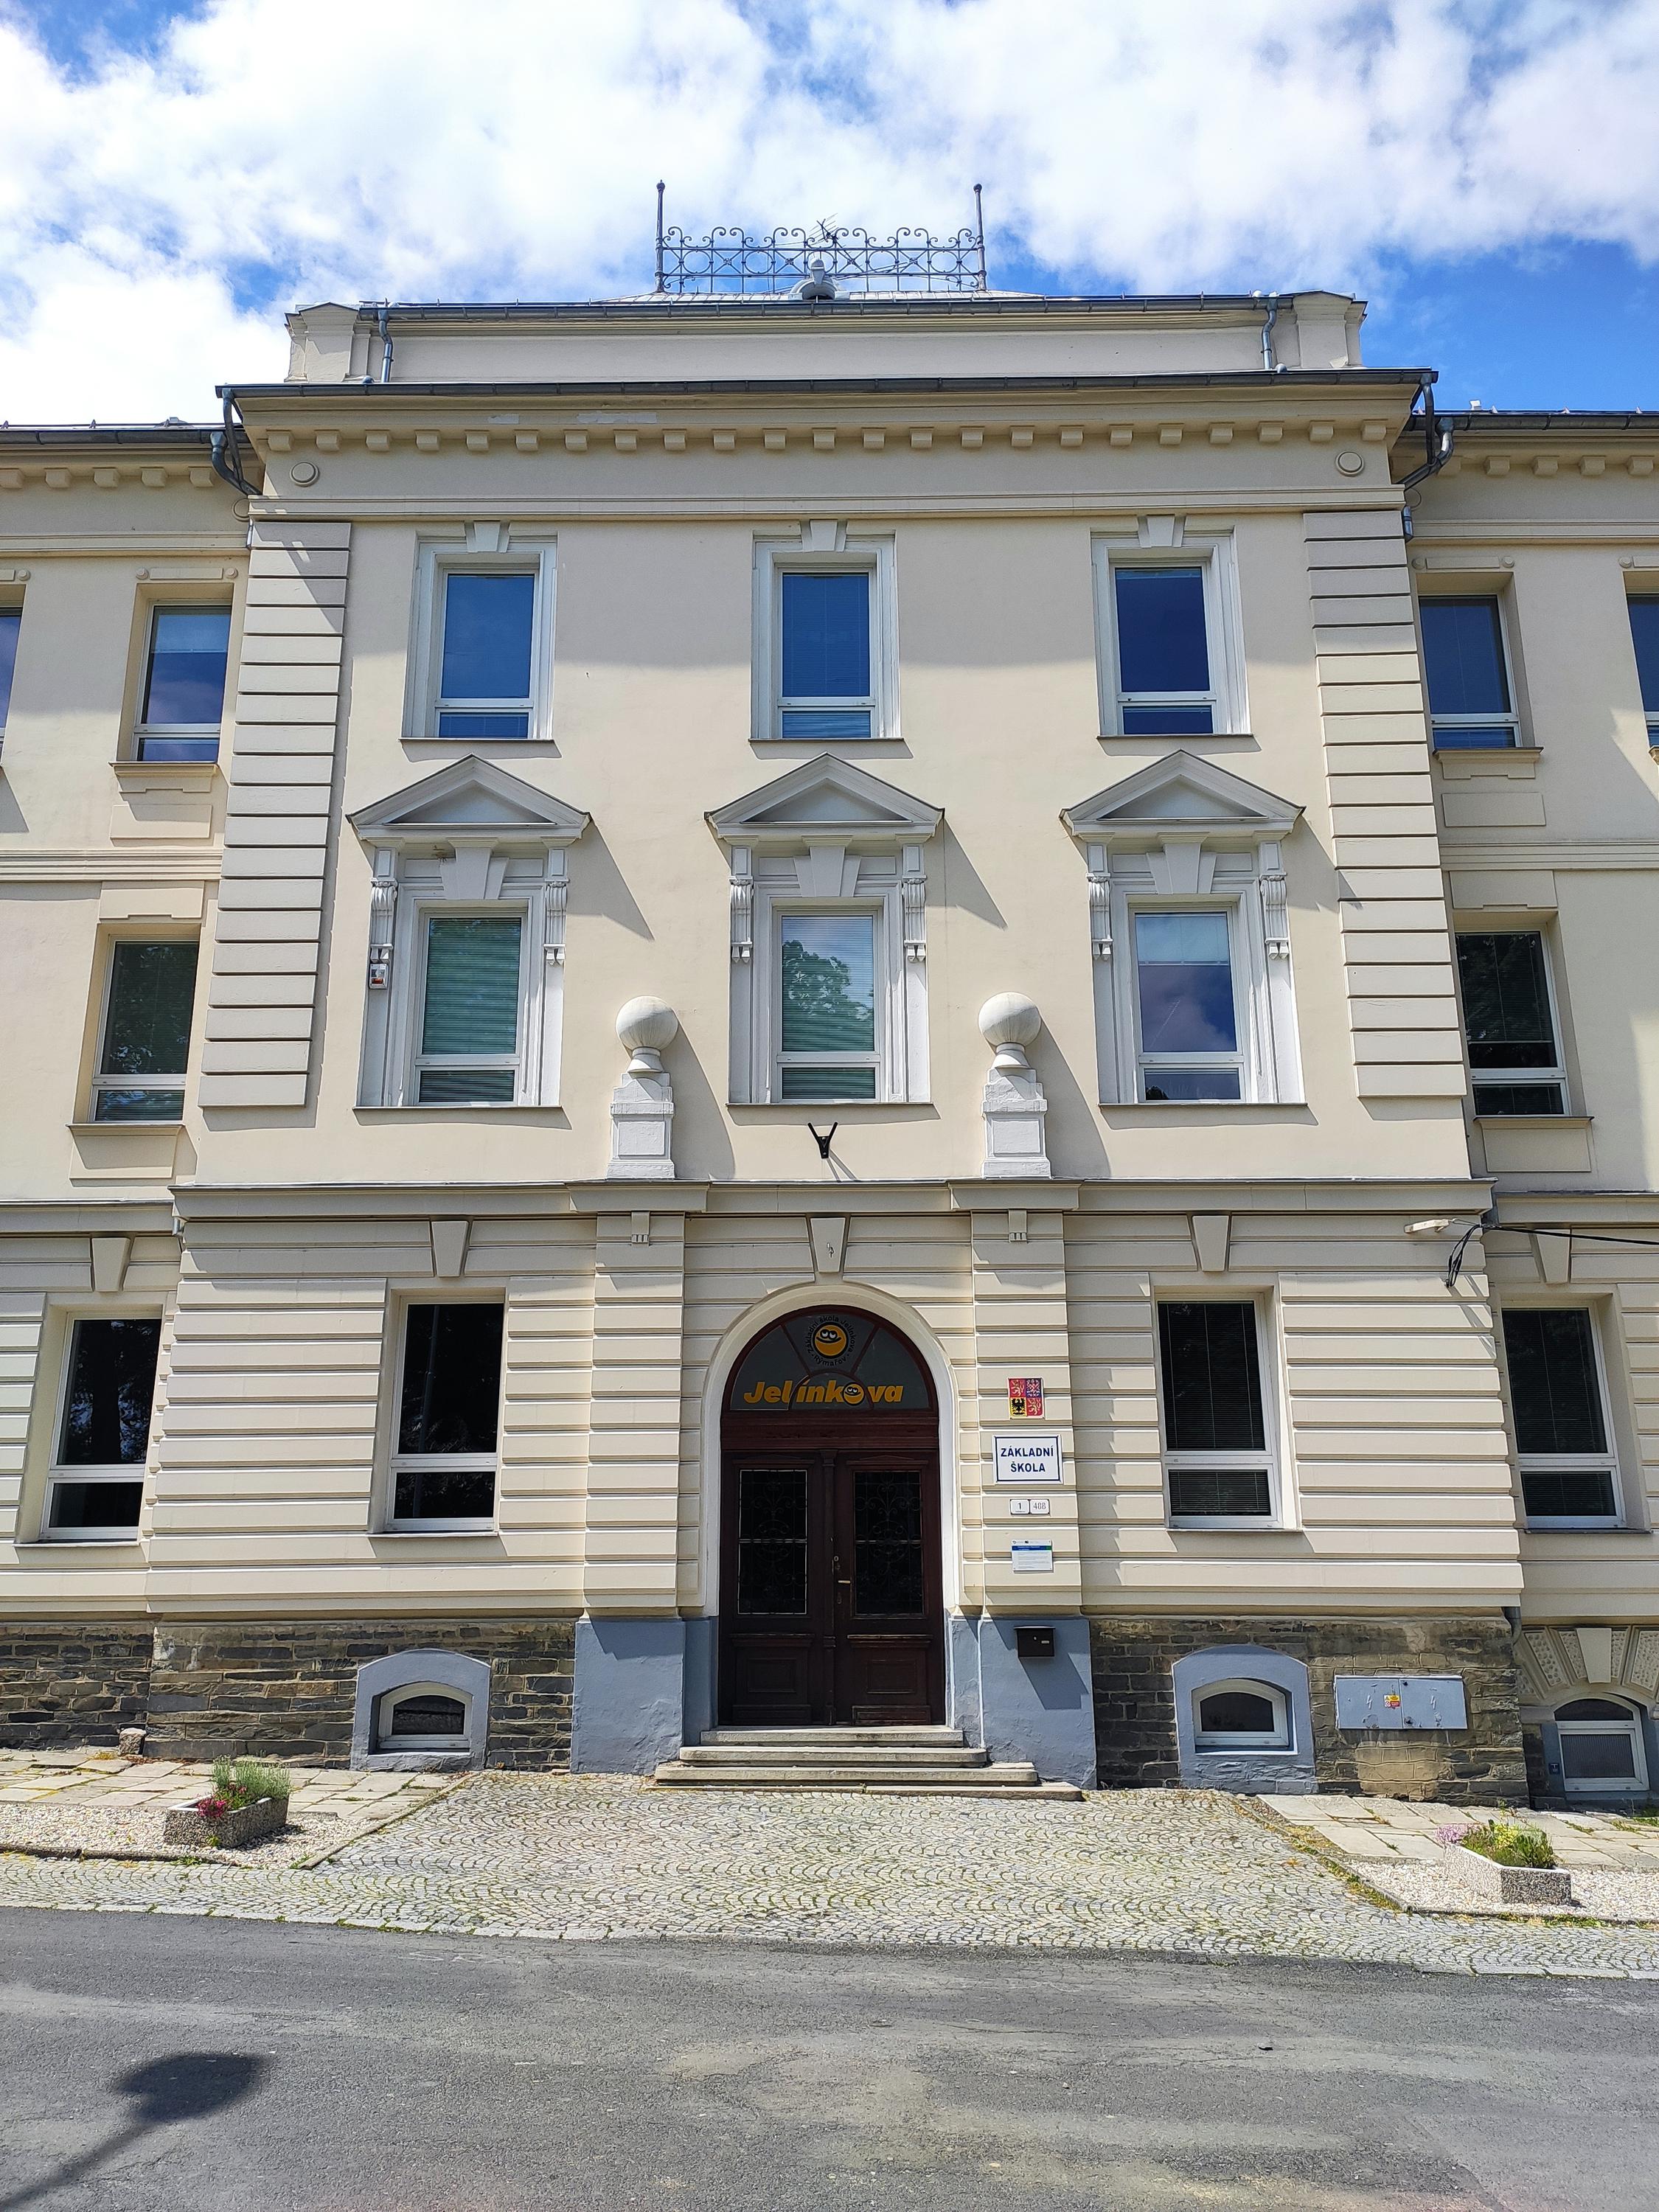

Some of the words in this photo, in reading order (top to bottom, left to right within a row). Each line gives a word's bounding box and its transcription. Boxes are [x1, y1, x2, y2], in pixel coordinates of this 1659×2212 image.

[805, 1320, 818, 1354] Základní
[819, 1315, 839, 1323] škola
[1001, 1445, 1054, 1457] ZÁKLADNÍ
[1010, 1461, 1046, 1472] ŠKOLA
